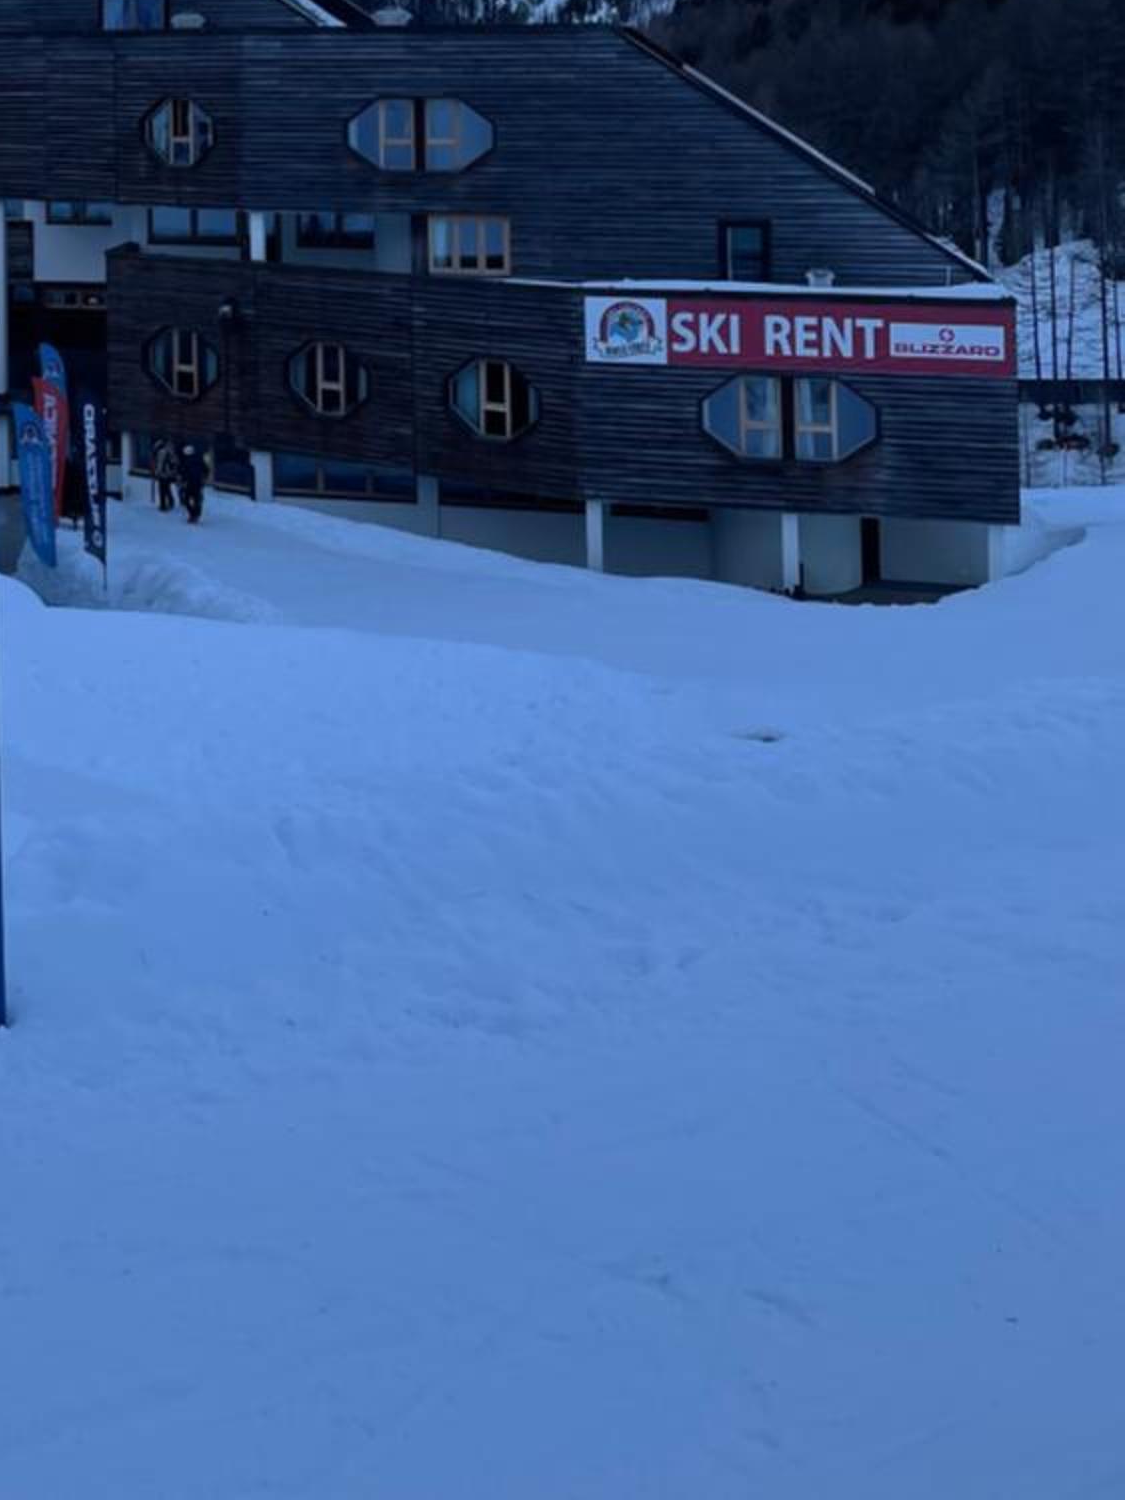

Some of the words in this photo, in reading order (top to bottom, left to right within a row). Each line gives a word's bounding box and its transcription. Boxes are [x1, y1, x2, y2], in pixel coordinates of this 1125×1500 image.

[670, 311, 740, 355] SKI
[763, 313, 885, 360] RENT
[893, 342, 1001, 357] BLIZZARD
